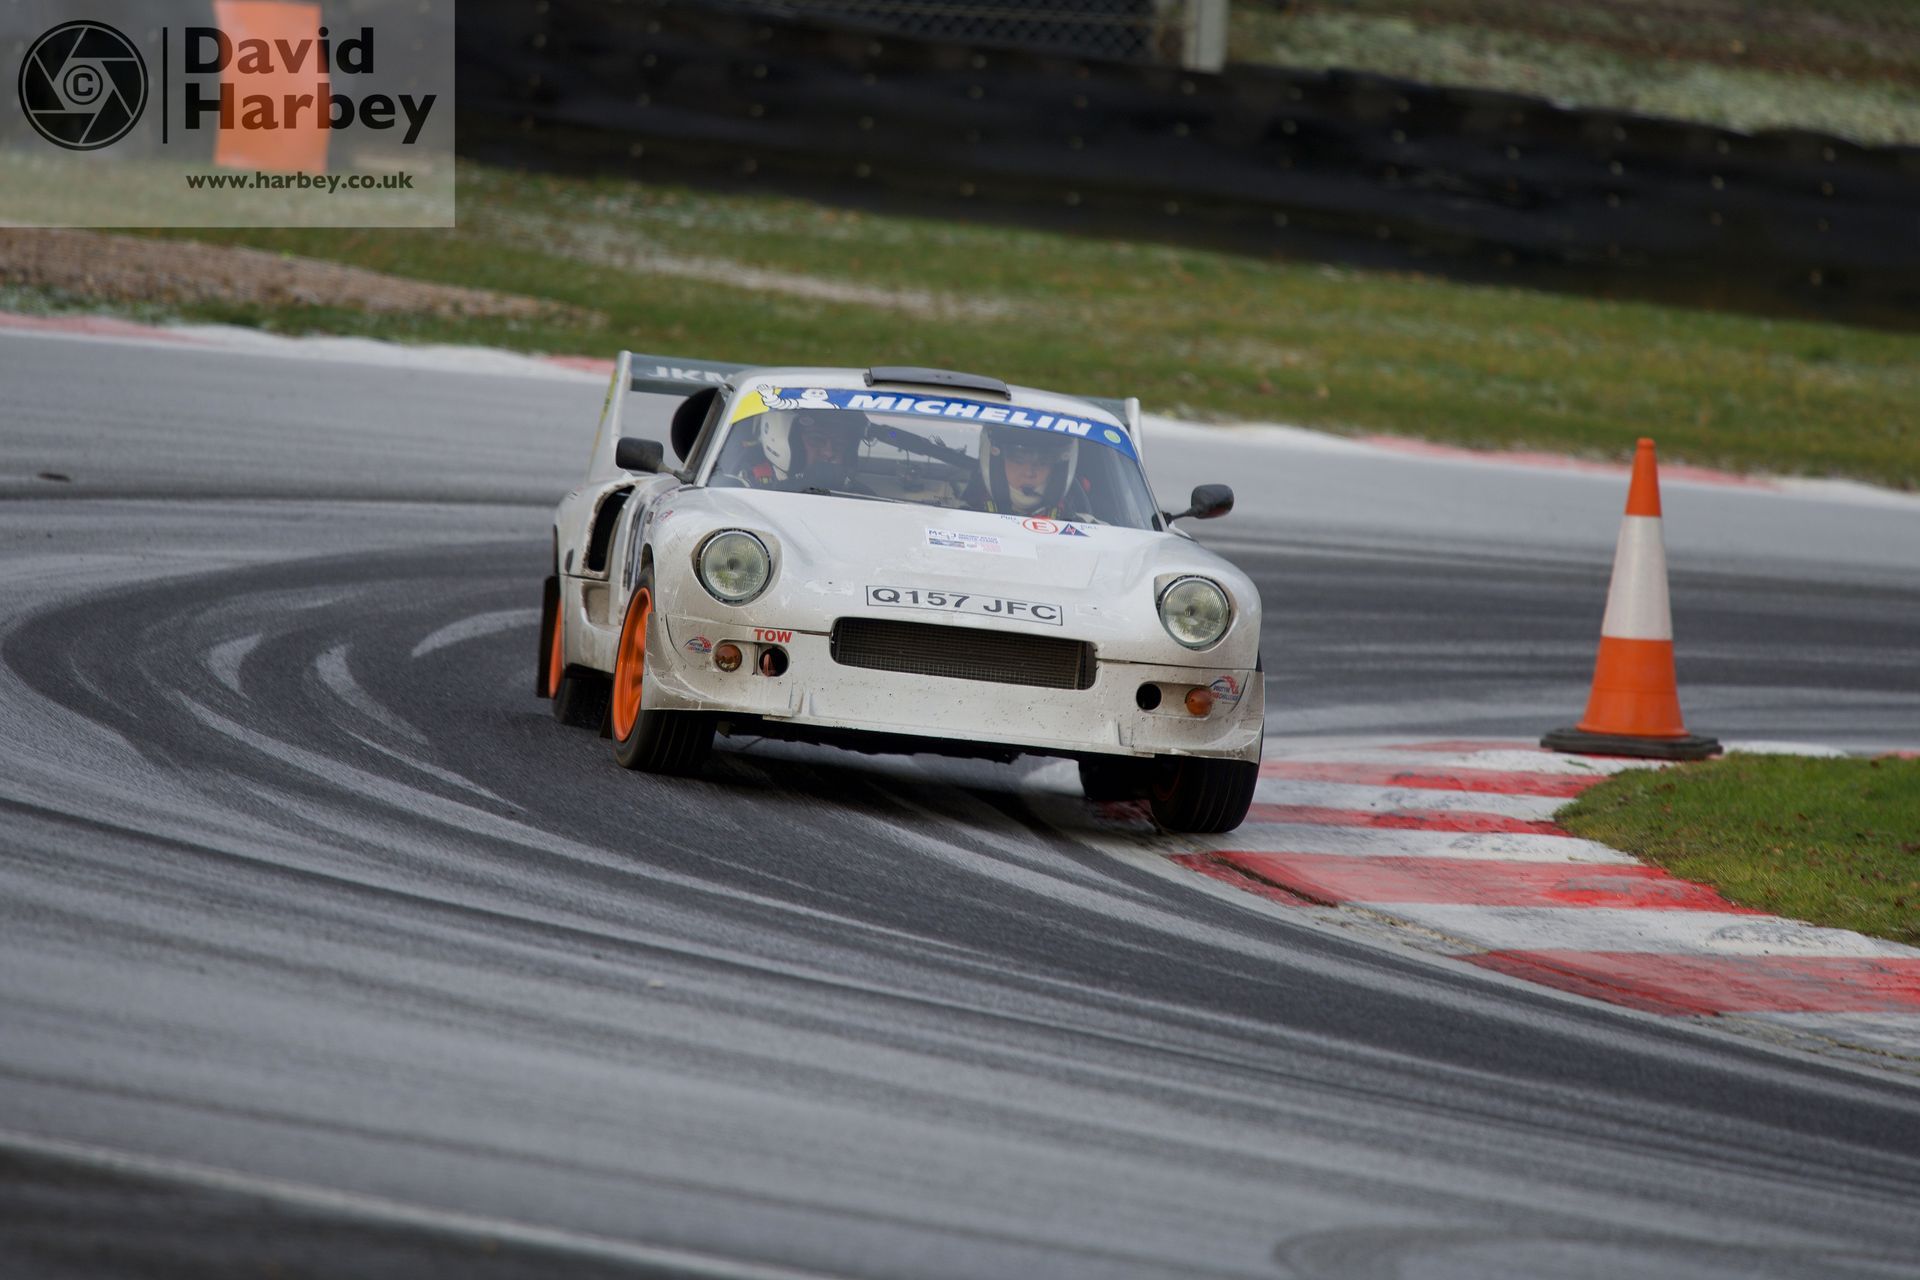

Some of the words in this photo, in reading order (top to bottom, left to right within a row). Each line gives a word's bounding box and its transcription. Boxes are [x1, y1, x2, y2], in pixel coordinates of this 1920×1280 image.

[848, 394, 1092, 436] MICHELIN
[872, 588, 970, 608] Q157
[983, 599, 1057, 620] JFC
[754, 628, 793, 643] TOW
